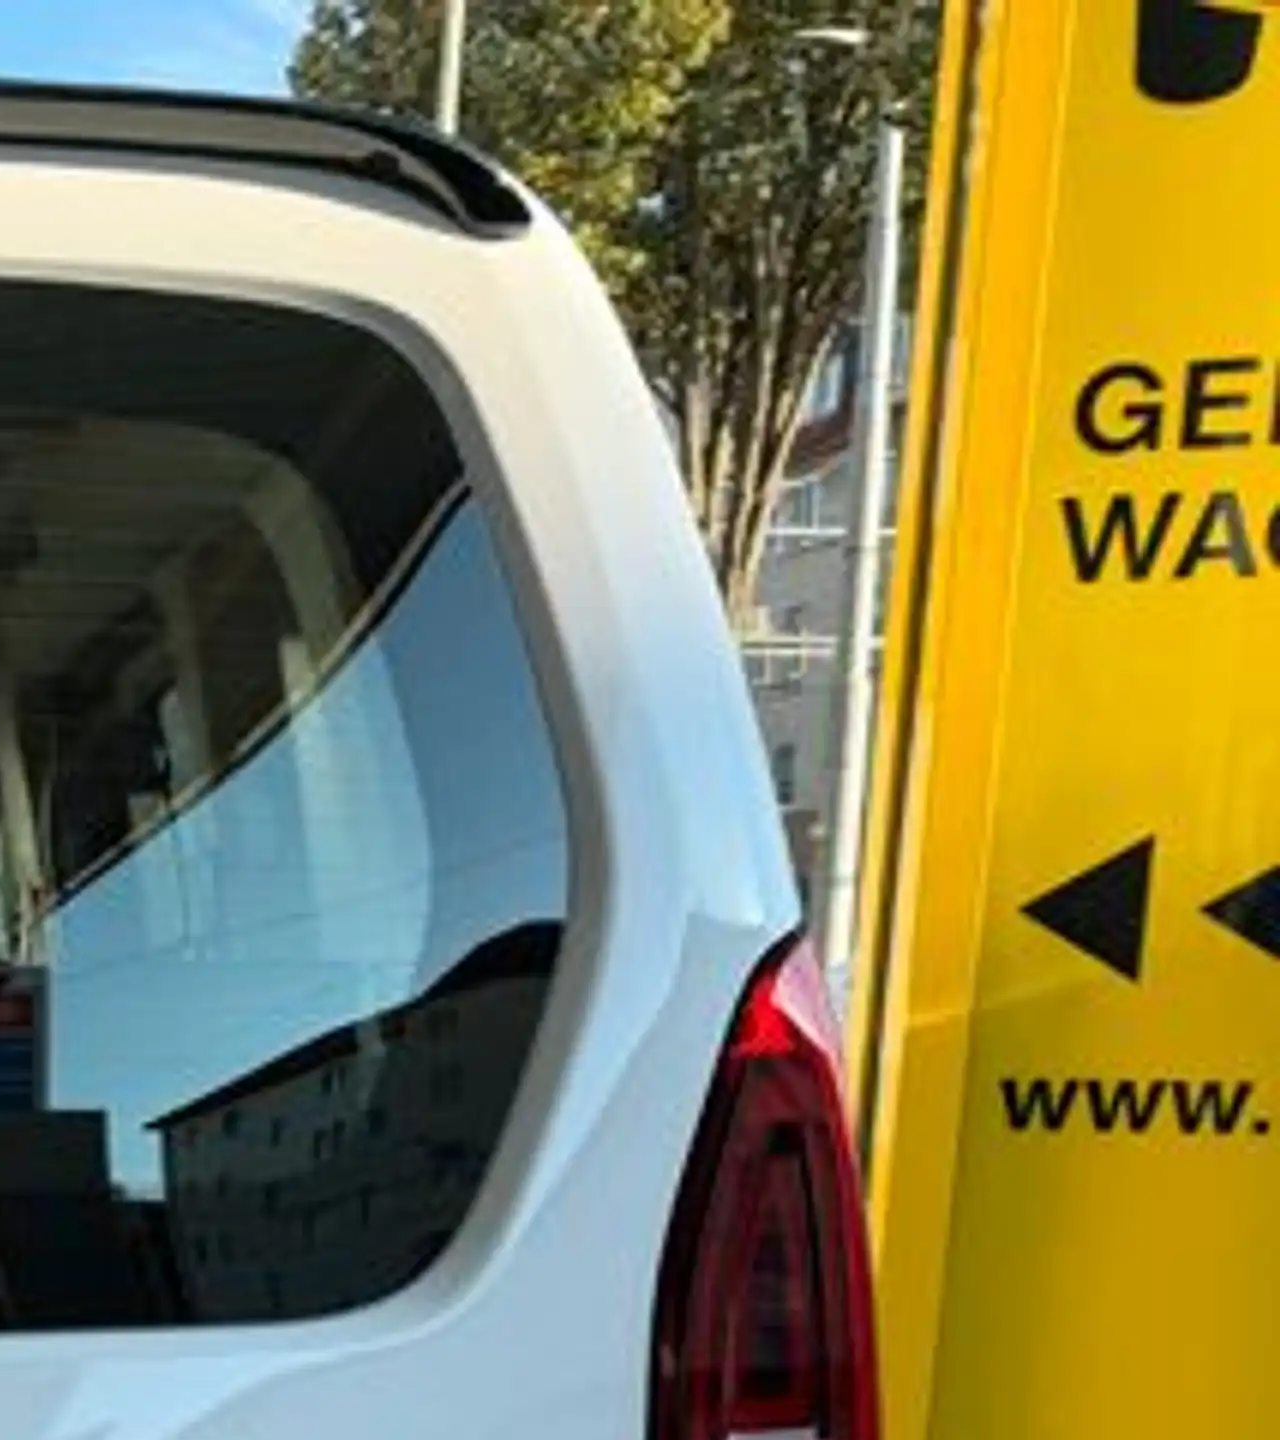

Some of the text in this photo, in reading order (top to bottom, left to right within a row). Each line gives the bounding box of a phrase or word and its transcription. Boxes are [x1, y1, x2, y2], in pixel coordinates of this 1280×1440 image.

[1075, 357, 1280, 456] GE
[1058, 492, 1280, 583] WA
[998, 1078, 1271, 1135] www.
